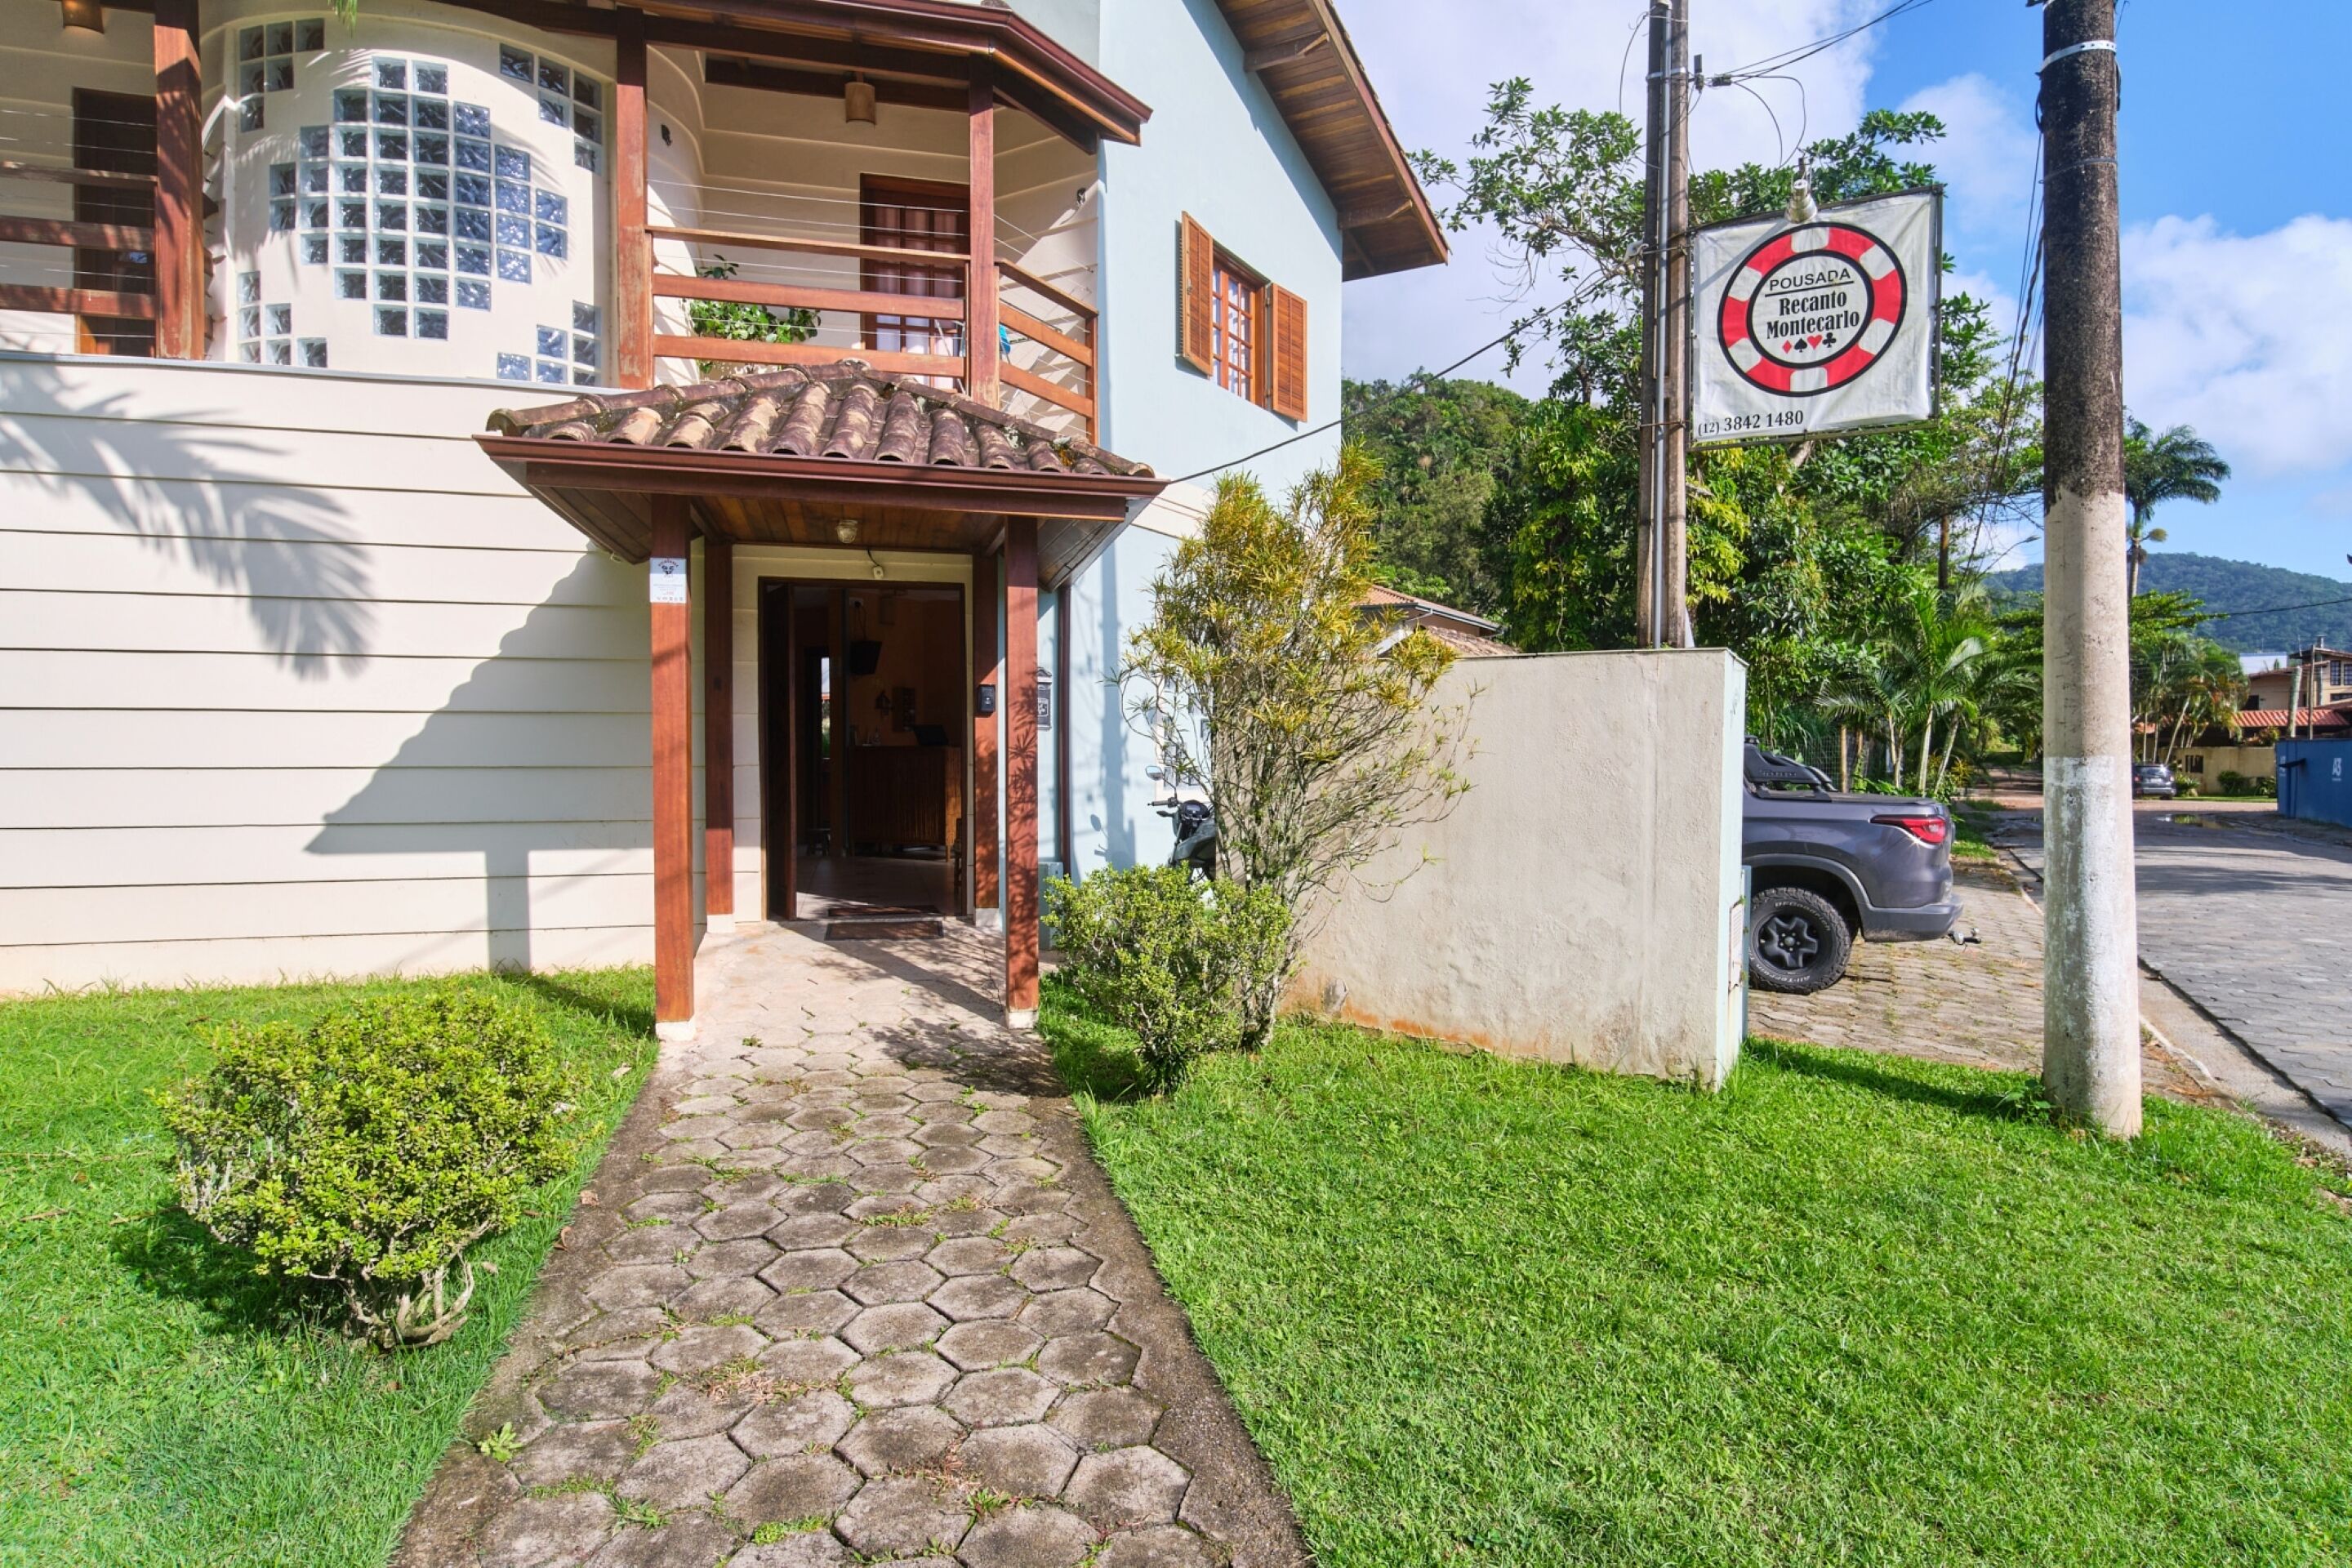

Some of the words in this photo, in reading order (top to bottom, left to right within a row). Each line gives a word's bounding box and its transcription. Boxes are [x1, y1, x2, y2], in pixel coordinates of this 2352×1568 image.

[1770, 269, 1851, 291] POUSADA
[1779, 291, 1847, 316] Recanto
[1766, 310, 1860, 339] Montecarlo
[1698, 421, 1721, 437] (12)
[1723, 414, 1762, 431] 3842
[1766, 410, 1804, 428] 1480
